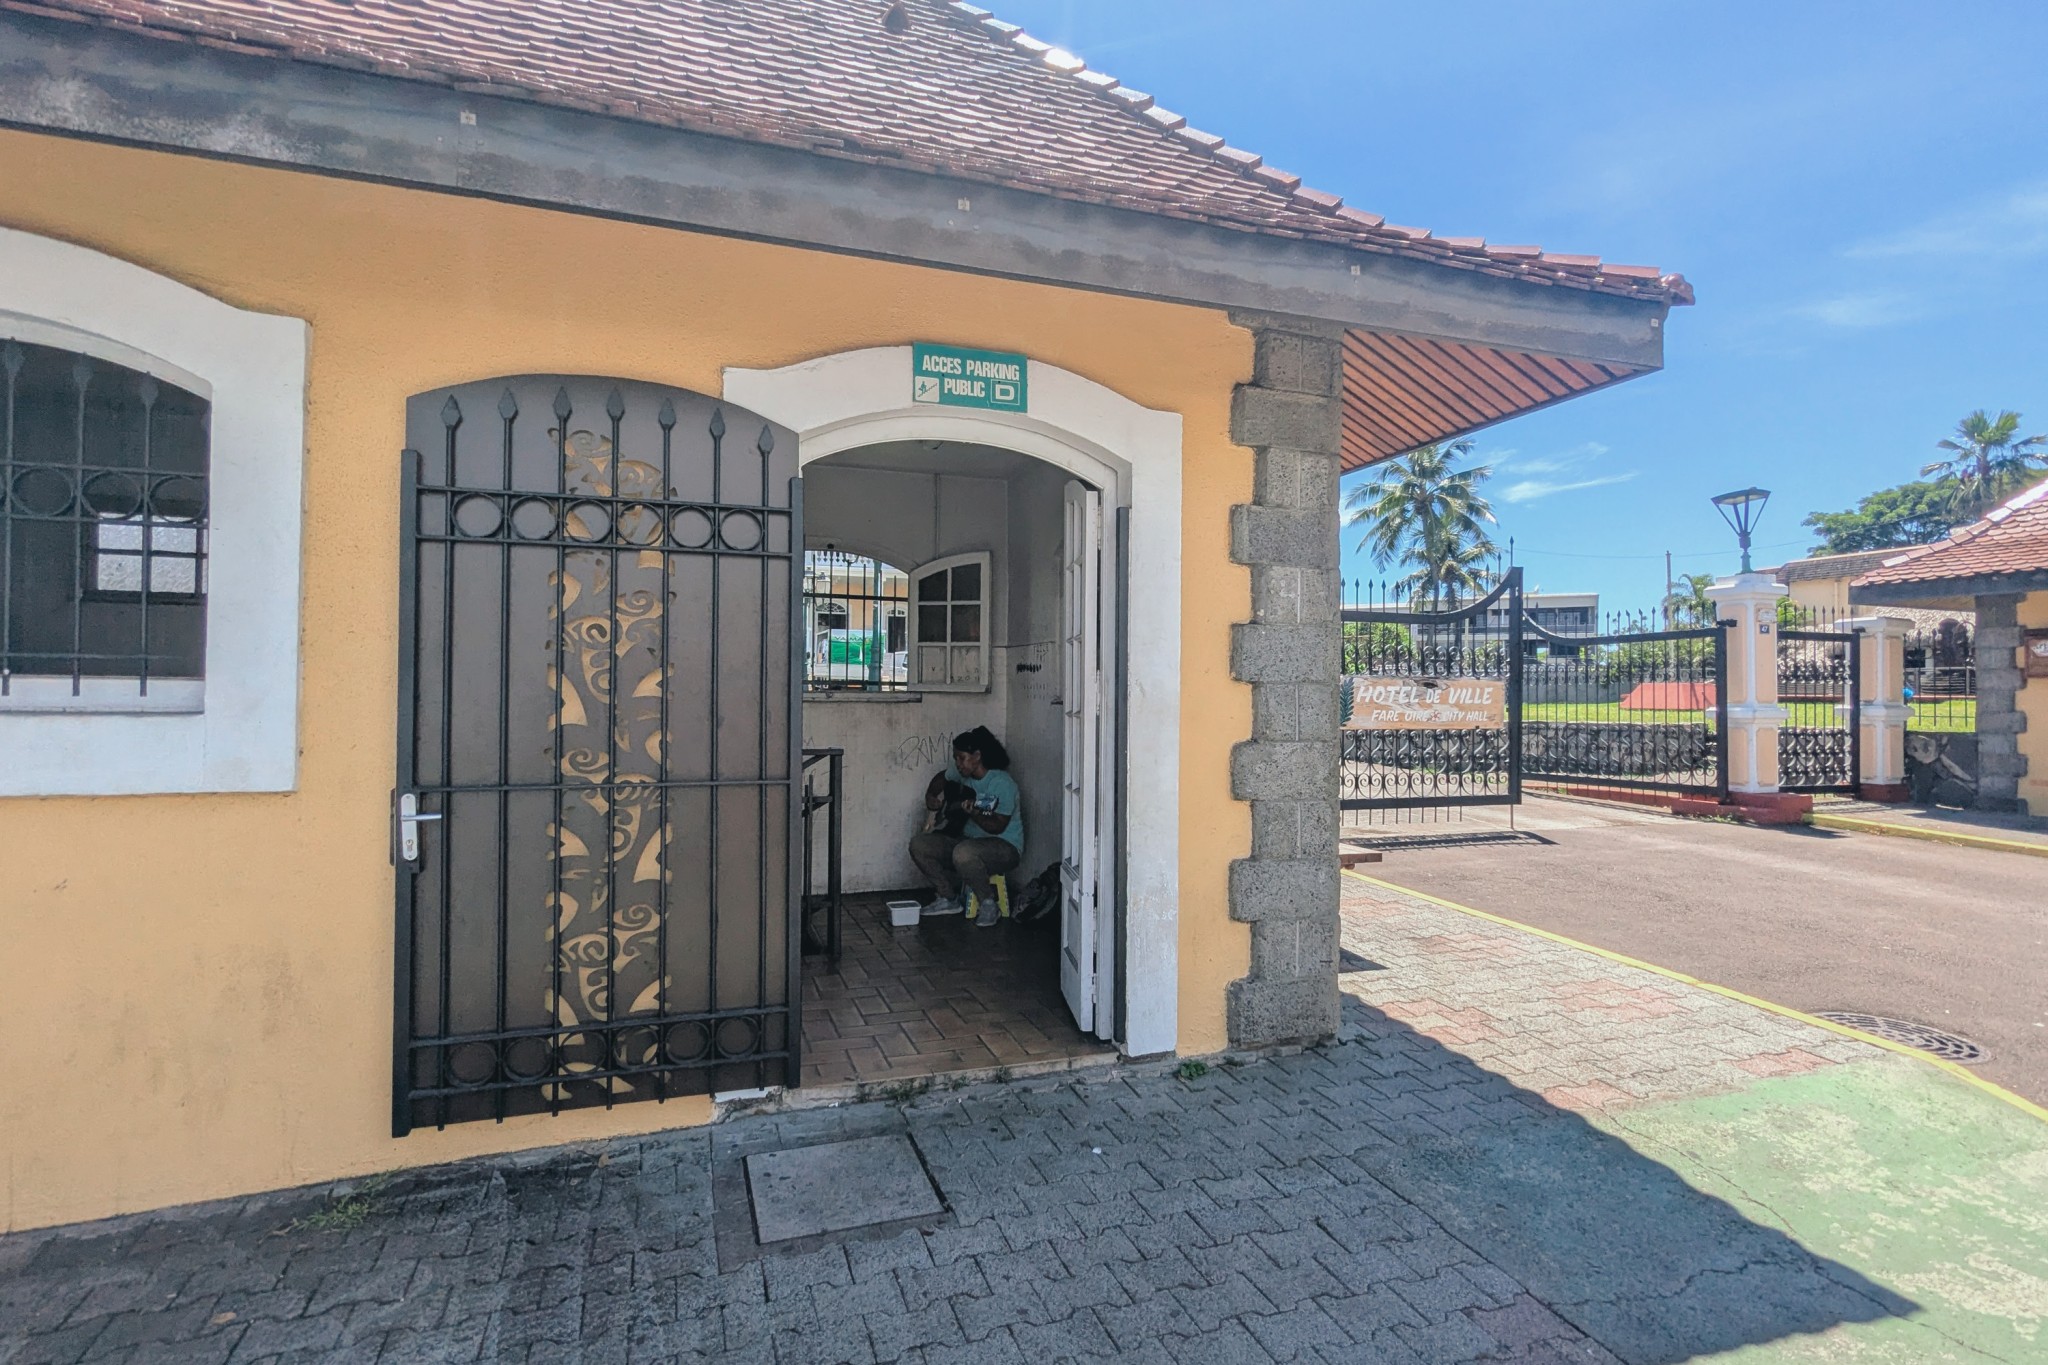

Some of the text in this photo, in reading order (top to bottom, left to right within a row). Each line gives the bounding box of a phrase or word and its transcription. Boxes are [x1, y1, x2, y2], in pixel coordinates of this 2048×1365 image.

[922, 354, 1020, 381] ACCES PARKING
[943, 378, 986, 398] PUBLIC
[1356, 685, 1420, 704] HOTEL
[1449, 687, 1494, 705] VILLE
[1371, 709, 1400, 722] FARE
[1442, 710, 1465, 722] CITY
[1466, 710, 1488, 722] HALL
